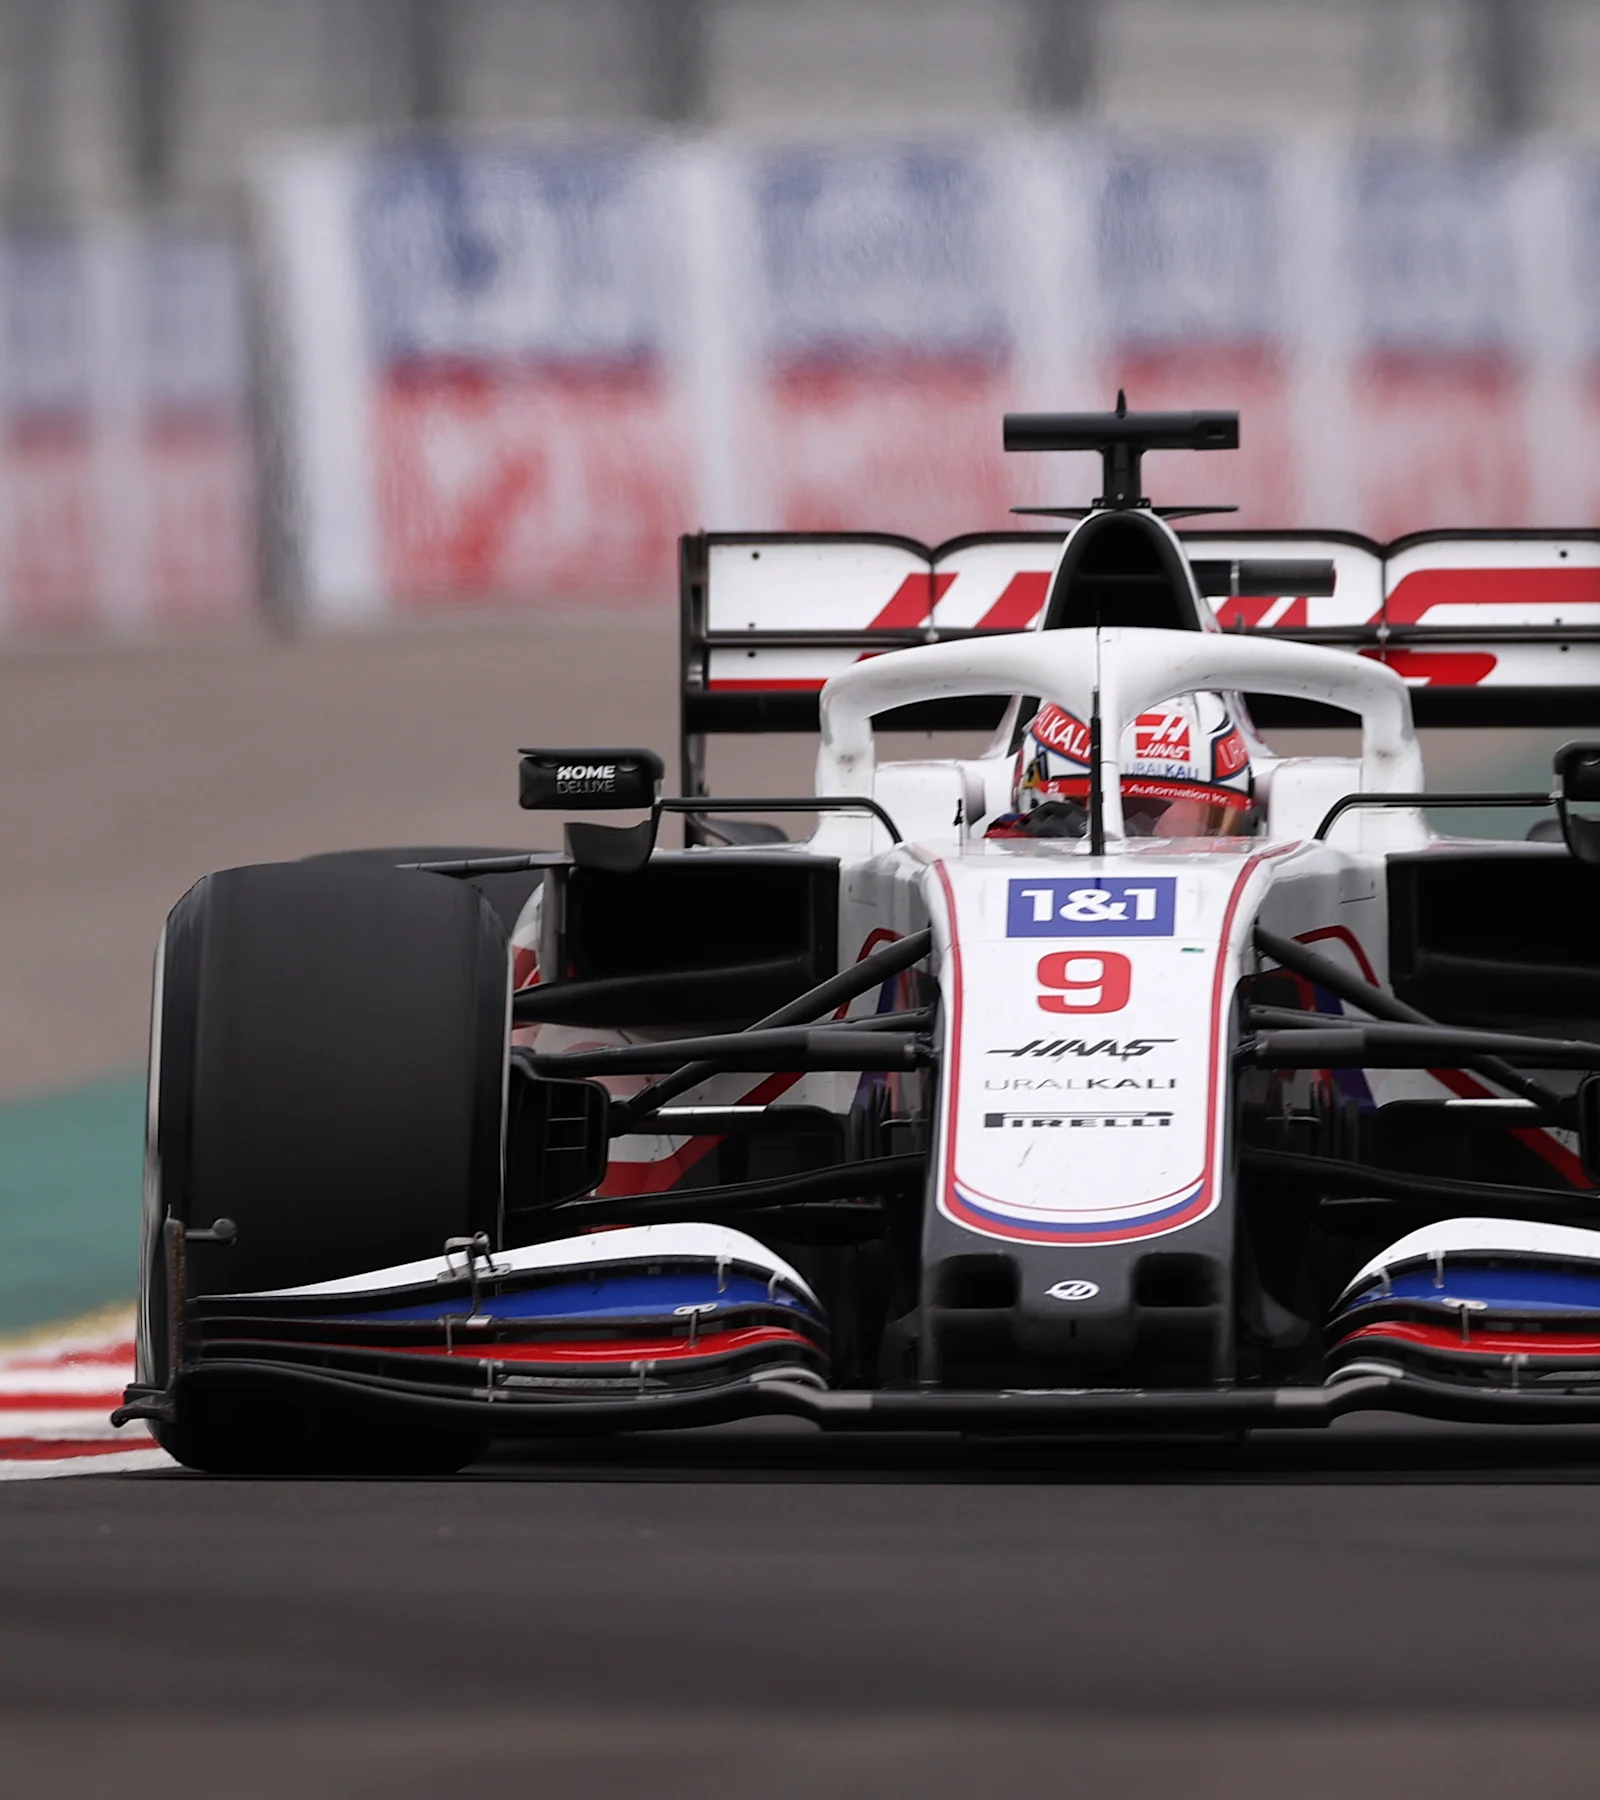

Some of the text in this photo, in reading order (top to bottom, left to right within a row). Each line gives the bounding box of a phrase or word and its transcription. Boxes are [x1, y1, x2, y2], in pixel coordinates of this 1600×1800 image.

[556, 765, 616, 780] HOME
[556, 780, 616, 794] DELUXE
[1128, 784, 1210, 800] Automation
[1020, 887, 1158, 921] 1&1
[1036, 950, 1132, 1014] 9
[985, 1039, 1178, 1058] HAAS
[985, 1078, 1176, 1091] URALKALI
[984, 1111, 1175, 1128] PIRELLI
